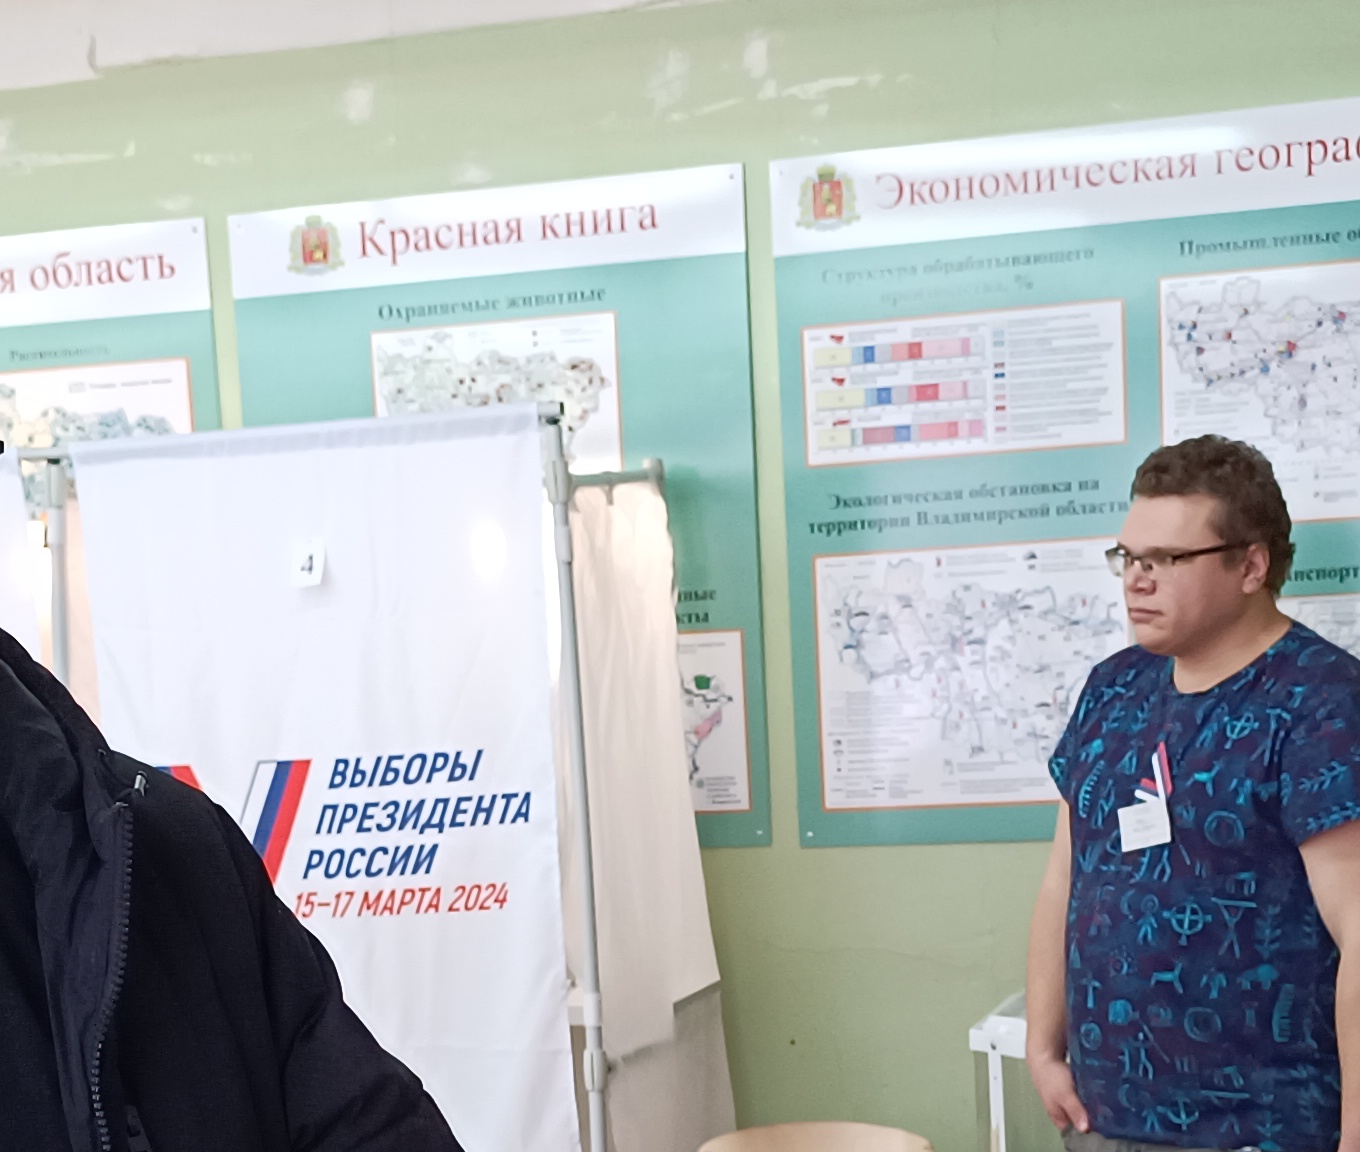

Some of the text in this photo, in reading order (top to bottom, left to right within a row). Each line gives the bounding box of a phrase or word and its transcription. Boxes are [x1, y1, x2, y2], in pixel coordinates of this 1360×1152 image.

[874, 150, 1197, 208] Экономическая
[357, 203, 660, 266] Красная книга
[1179, 229, 1340, 257] Промышленные
[29, 250, 177, 292] область
[377, 287, 606, 324] Охраняемые животные
[828, 478, 1100, 510] Экологическая обстановка на
[809, 514, 911, 537] территории
[917, 503, 1051, 526] Владимирской
[300, 553, 314, 575] 4
[328, 749, 485, 790] ВЫБОРЫ
[315, 791, 532, 835] ПРЕЗИДЕНТА
[303, 843, 440, 880] РОССИИ
[357, 886, 442, 918] МАРТА
[448, 882, 509, 913] 2024
